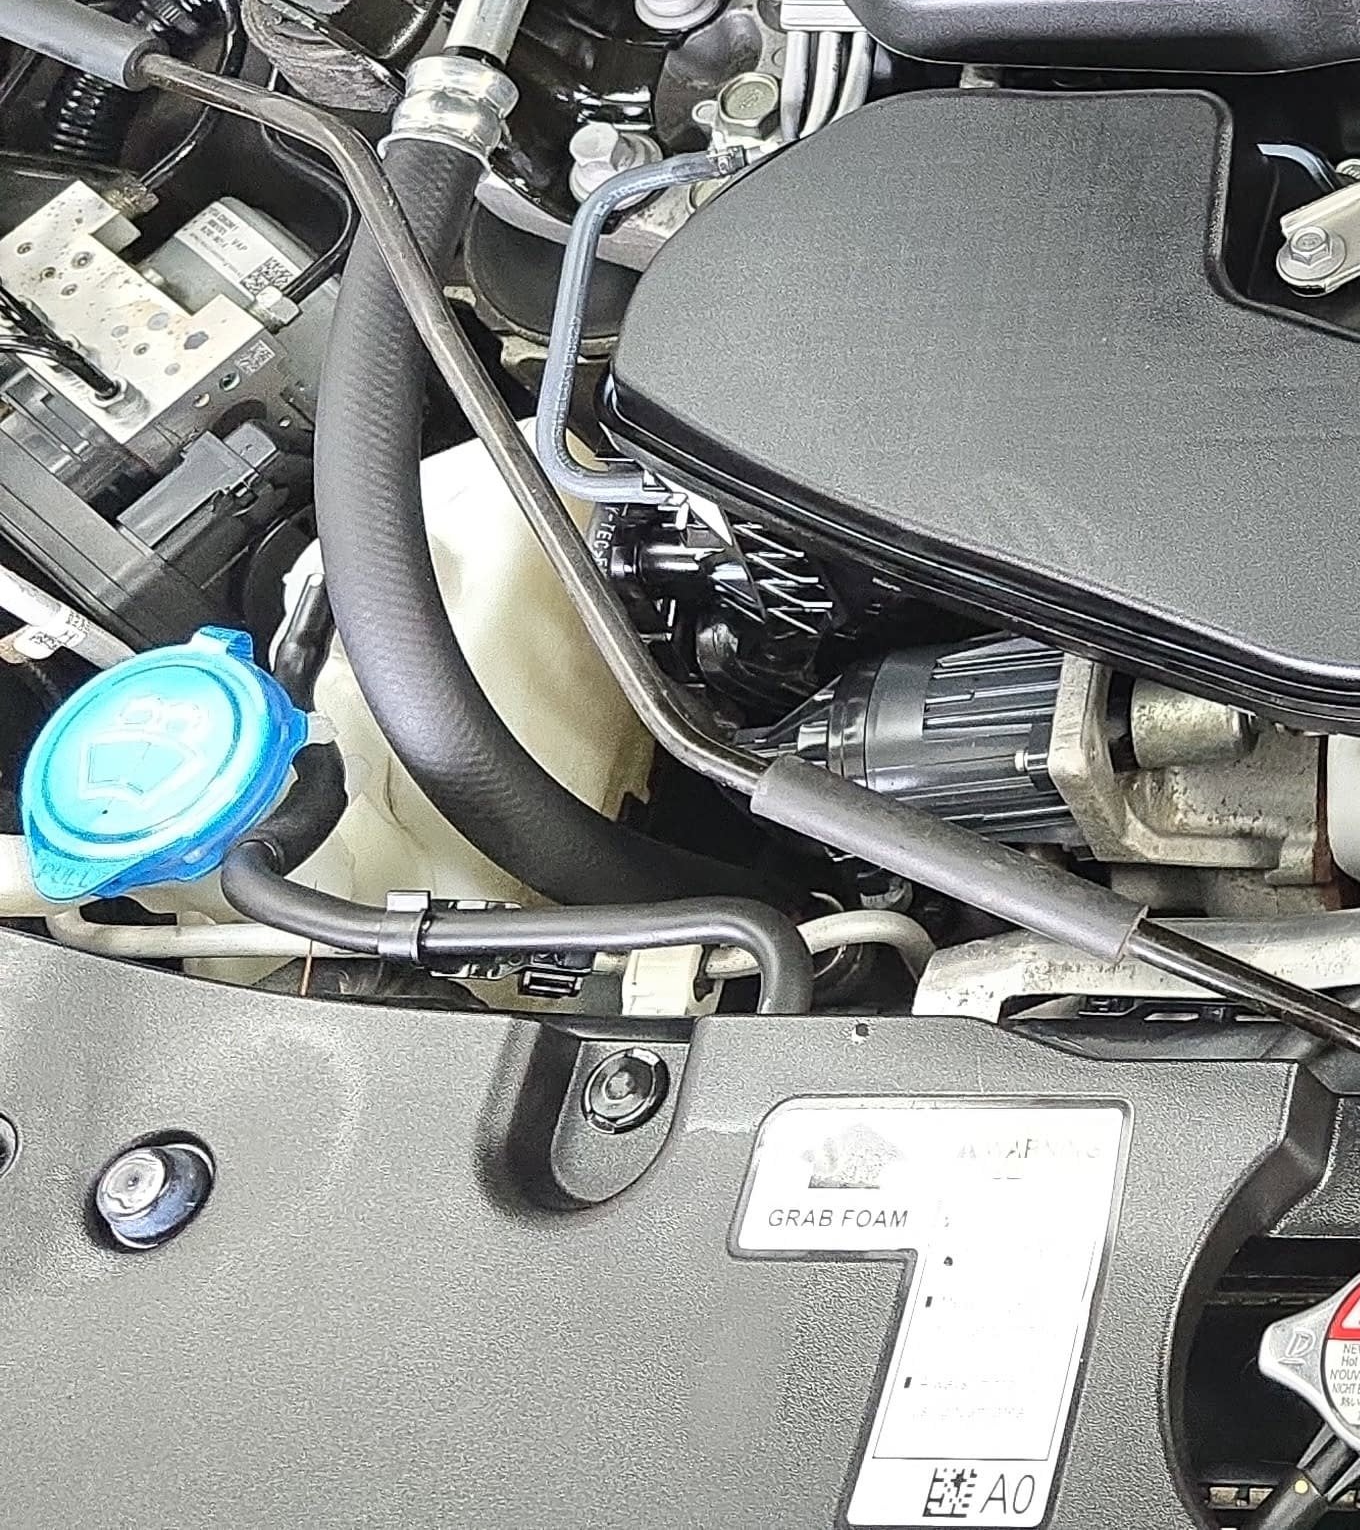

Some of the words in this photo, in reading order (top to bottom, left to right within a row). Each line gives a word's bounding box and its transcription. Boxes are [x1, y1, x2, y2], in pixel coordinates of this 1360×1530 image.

[768, 1209, 834, 1228] GRAB
[841, 1209, 909, 1229] FOAM
[1341, 1356, 1358, 1367] Hot
[1332, 1382, 1358, 1394] NICHT
[980, 1474, 1036, 1515] A0
